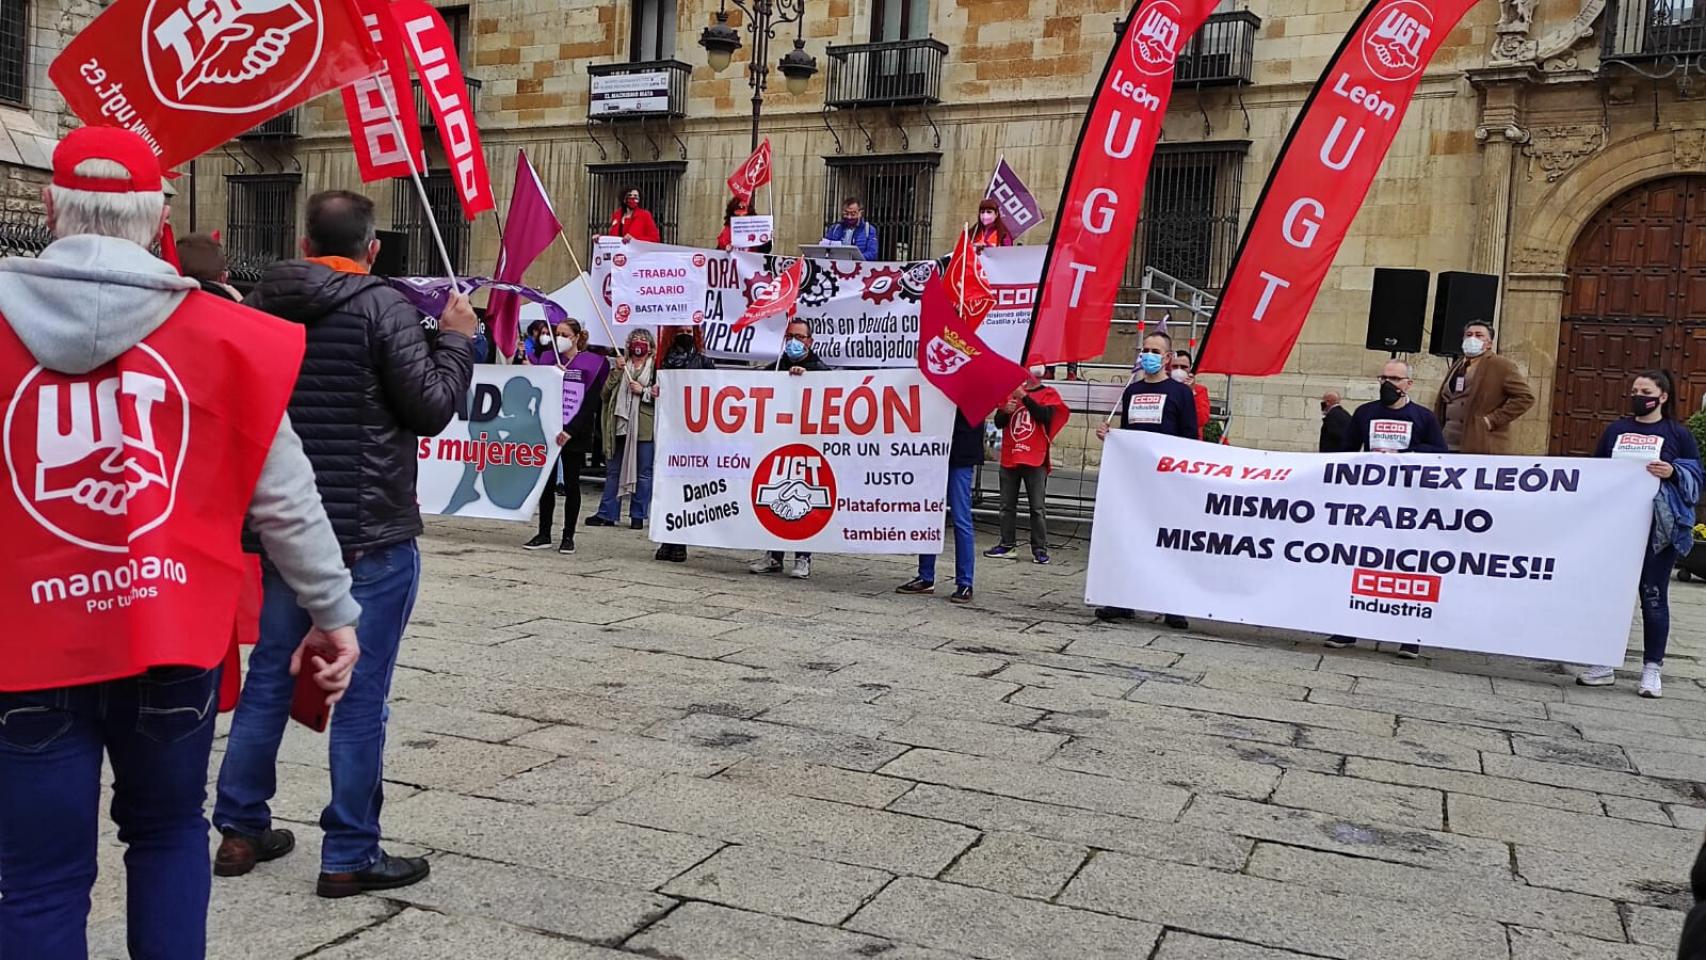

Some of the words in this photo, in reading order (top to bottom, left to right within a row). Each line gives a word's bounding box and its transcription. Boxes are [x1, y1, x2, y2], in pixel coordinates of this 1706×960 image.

[1374, 8, 1431, 57] UGT
[1111, 69, 1160, 112] León
[1332, 72, 1396, 121] León
[635, 304, 664, 313] BASTA
[665, 303, 688, 312] YA!!!
[838, 317, 855, 336] en
[858, 311, 898, 334] deuda
[437, 432, 547, 472] mujeres
[668, 455, 709, 469] INDITEX
[716, 452, 751, 470] LEÓN
[823, 442, 851, 456] POR
[857, 443, 880, 456] UN
[768, 455, 822, 487] UGT
[864, 471, 915, 486] JUSTO
[1156, 456, 1233, 478] BASTA
[1240, 465, 1292, 481] YA!!
[1323, 463, 1463, 490] INDITEX
[1474, 464, 1580, 492] LEÓN
[683, 478, 727, 504] Danos
[665, 499, 740, 533] Soluciones
[837, 498, 921, 513] Plataforma
[1205, 493, 1315, 523] MISMO
[1325, 501, 1493, 533] TRABAJO
[843, 526, 906, 542] también
[1156, 528, 1275, 559] MISMAS
[1283, 541, 1556, 581] CONDICIONES!!
[1357, 573, 1430, 597] CCOO
[86, 599, 114, 613] Por
[1350, 595, 1432, 620] industria
